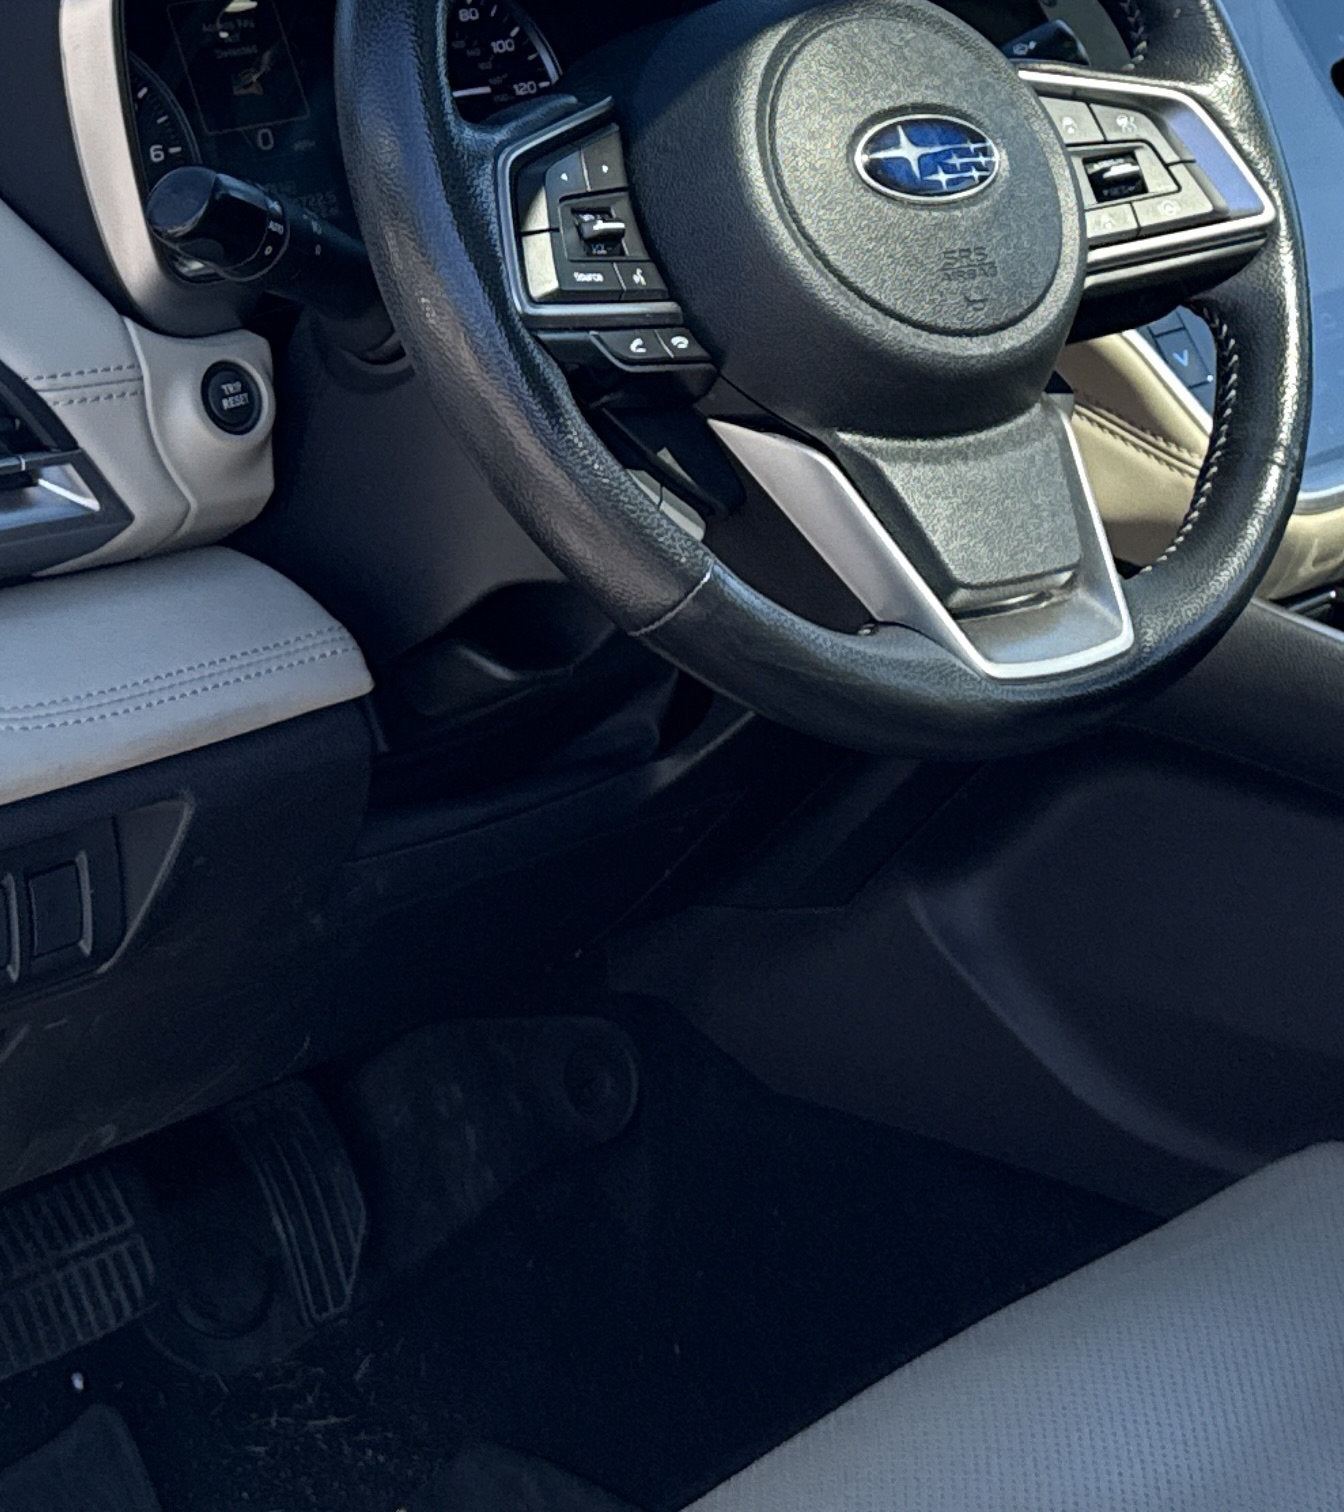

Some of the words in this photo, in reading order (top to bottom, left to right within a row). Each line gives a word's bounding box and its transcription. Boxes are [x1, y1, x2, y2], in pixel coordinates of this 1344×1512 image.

[459, 8, 479, 22] 80
[491, 39, 515, 53] 100
[513, 81, 537, 96] 120
[150, 145, 164, 162] 6
[942, 246, 988, 267] SRS
[221, 381, 242, 396] TRIP
[222, 393, 249, 410] RESET
